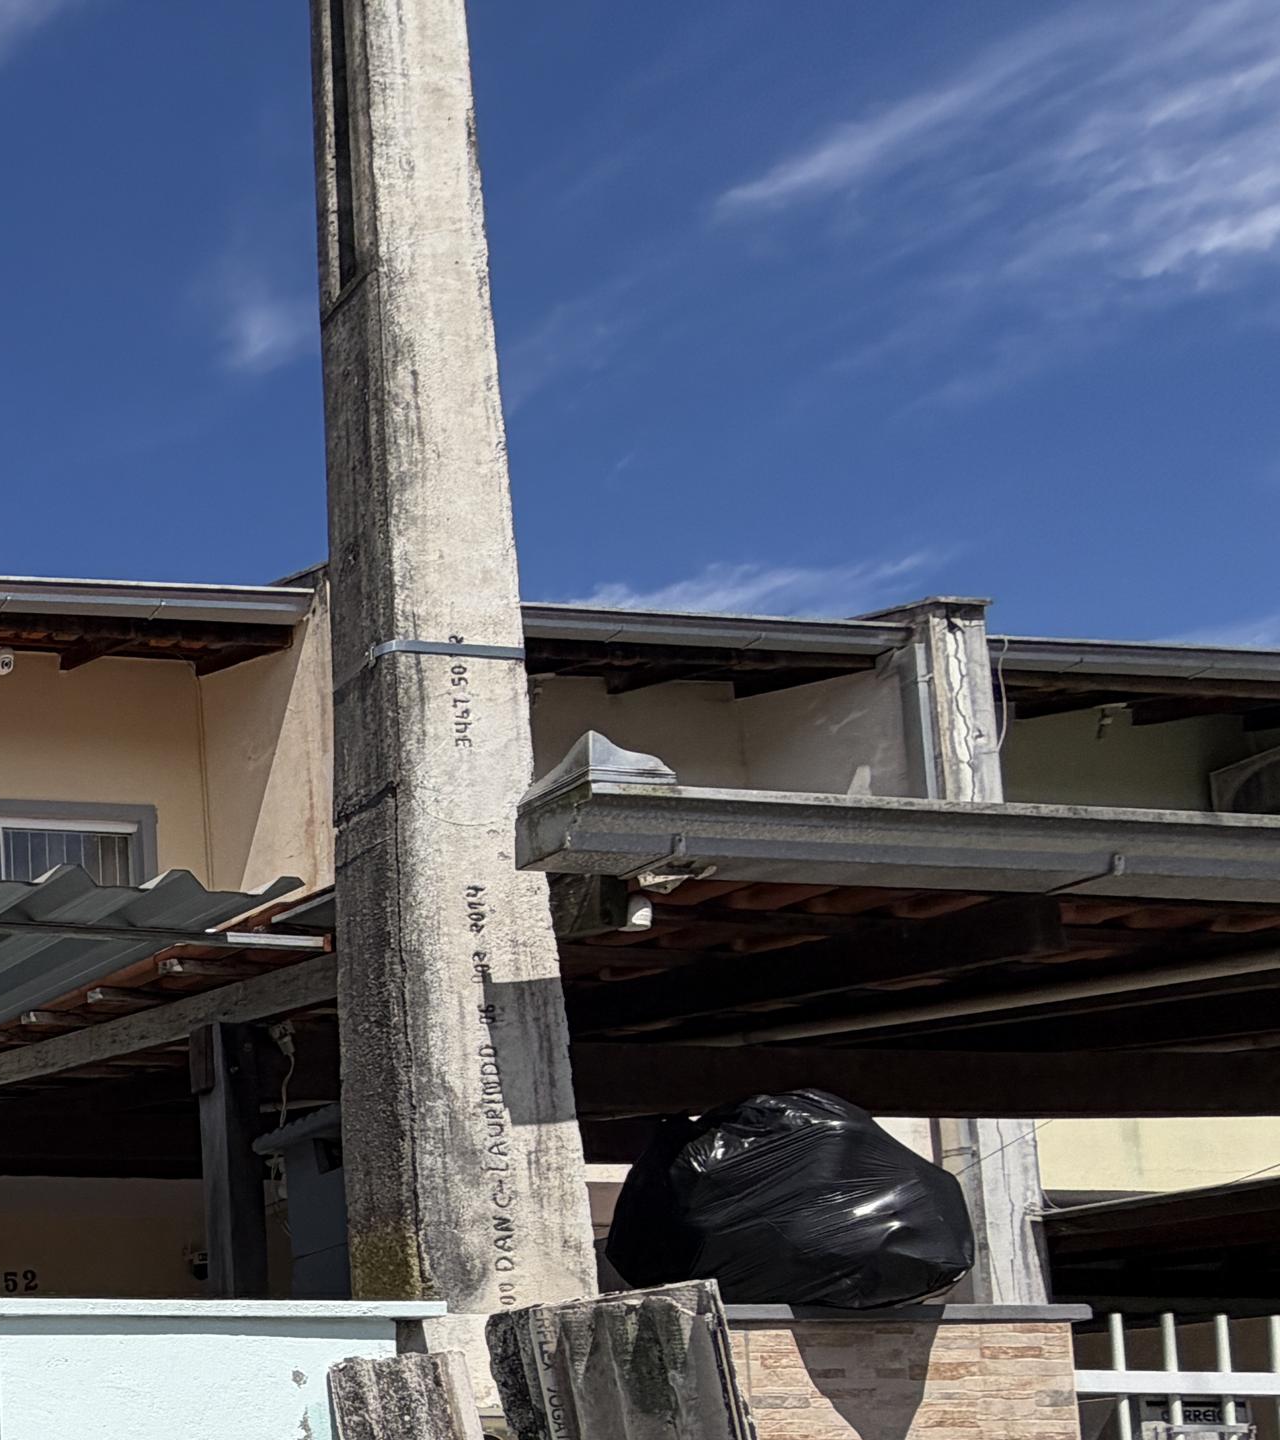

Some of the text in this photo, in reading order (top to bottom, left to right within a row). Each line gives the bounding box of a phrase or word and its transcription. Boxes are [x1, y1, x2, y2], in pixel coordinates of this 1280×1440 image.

[448, 634, 469, 687] 502
[3, 1269, 38, 1293] 52
[1161, 1409, 1222, 1422] CRREI
